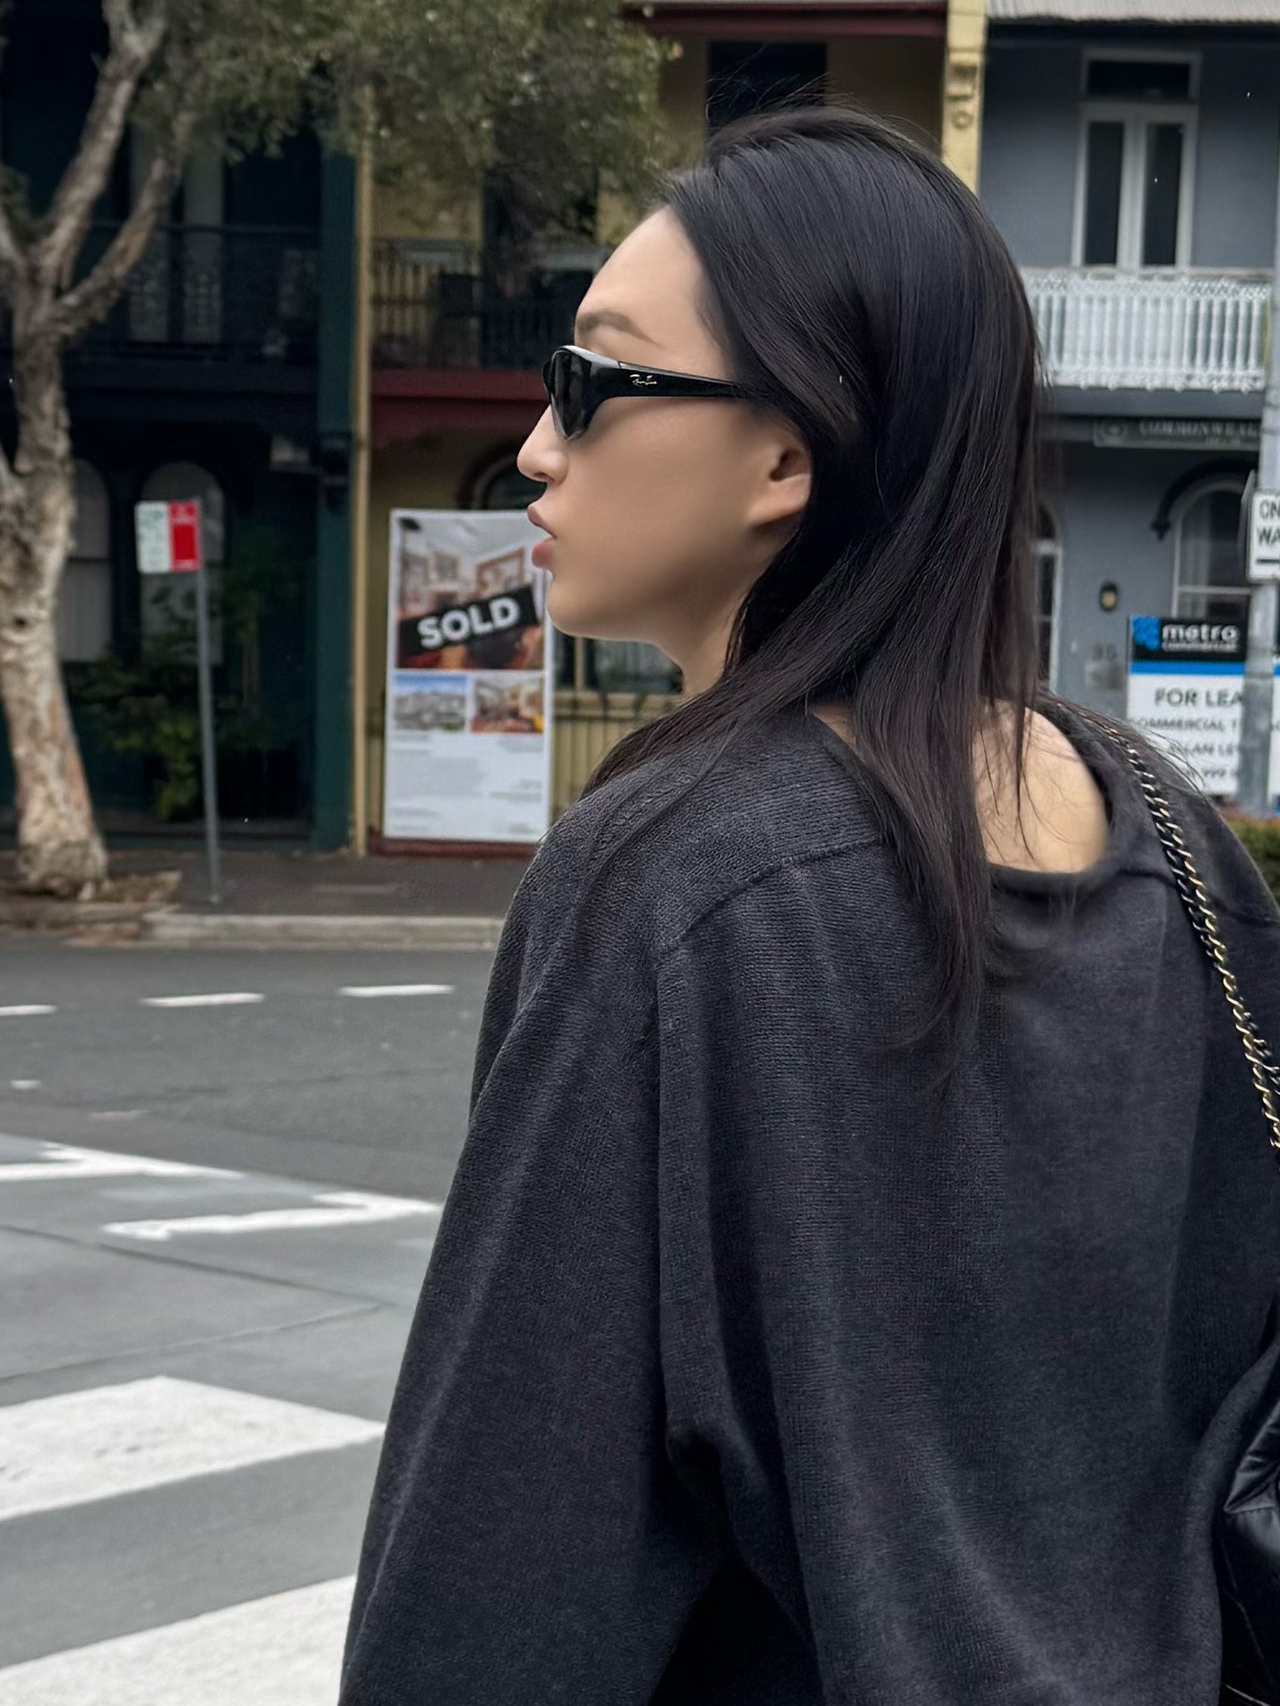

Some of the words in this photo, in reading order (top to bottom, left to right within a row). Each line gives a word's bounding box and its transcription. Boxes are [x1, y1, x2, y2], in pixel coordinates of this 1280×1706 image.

[1140, 418, 1261, 437] COMMONWEAL
[417, 597, 520, 649] SOLD
[1162, 623, 1239, 642] metro
[1154, 687, 1198, 707] FOR
[1205, 688, 1246, 707] LEA
